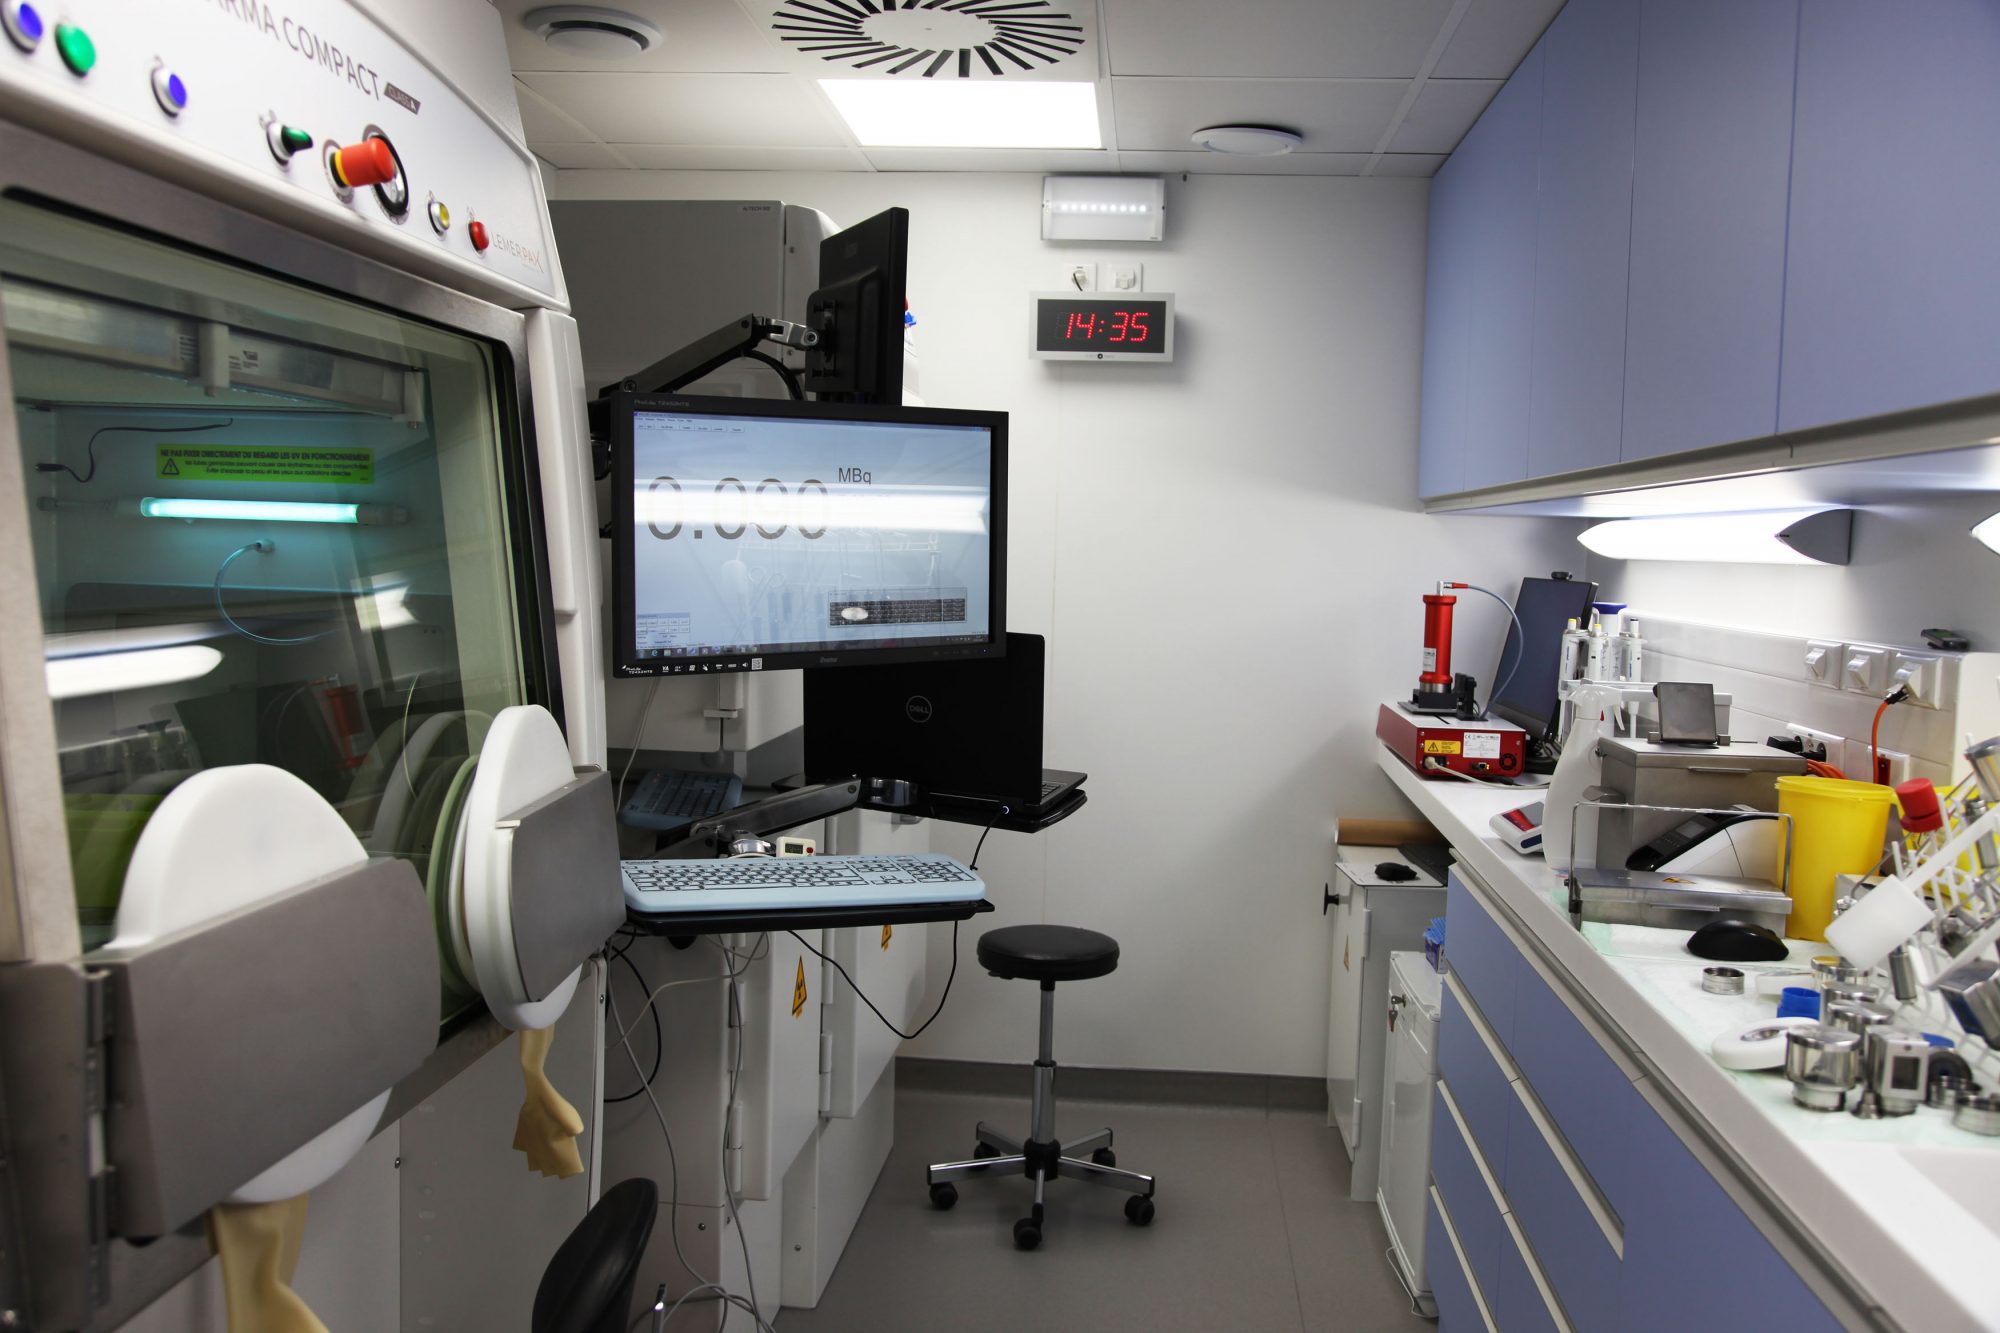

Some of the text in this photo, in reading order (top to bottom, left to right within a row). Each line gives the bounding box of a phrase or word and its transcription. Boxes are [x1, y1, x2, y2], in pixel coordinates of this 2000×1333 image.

[282, 17, 379, 101] COMPACT
[1065, 311, 1149, 342] 14:35
[838, 467, 872, 485] MBq
[909, 704, 930, 714] DELL
